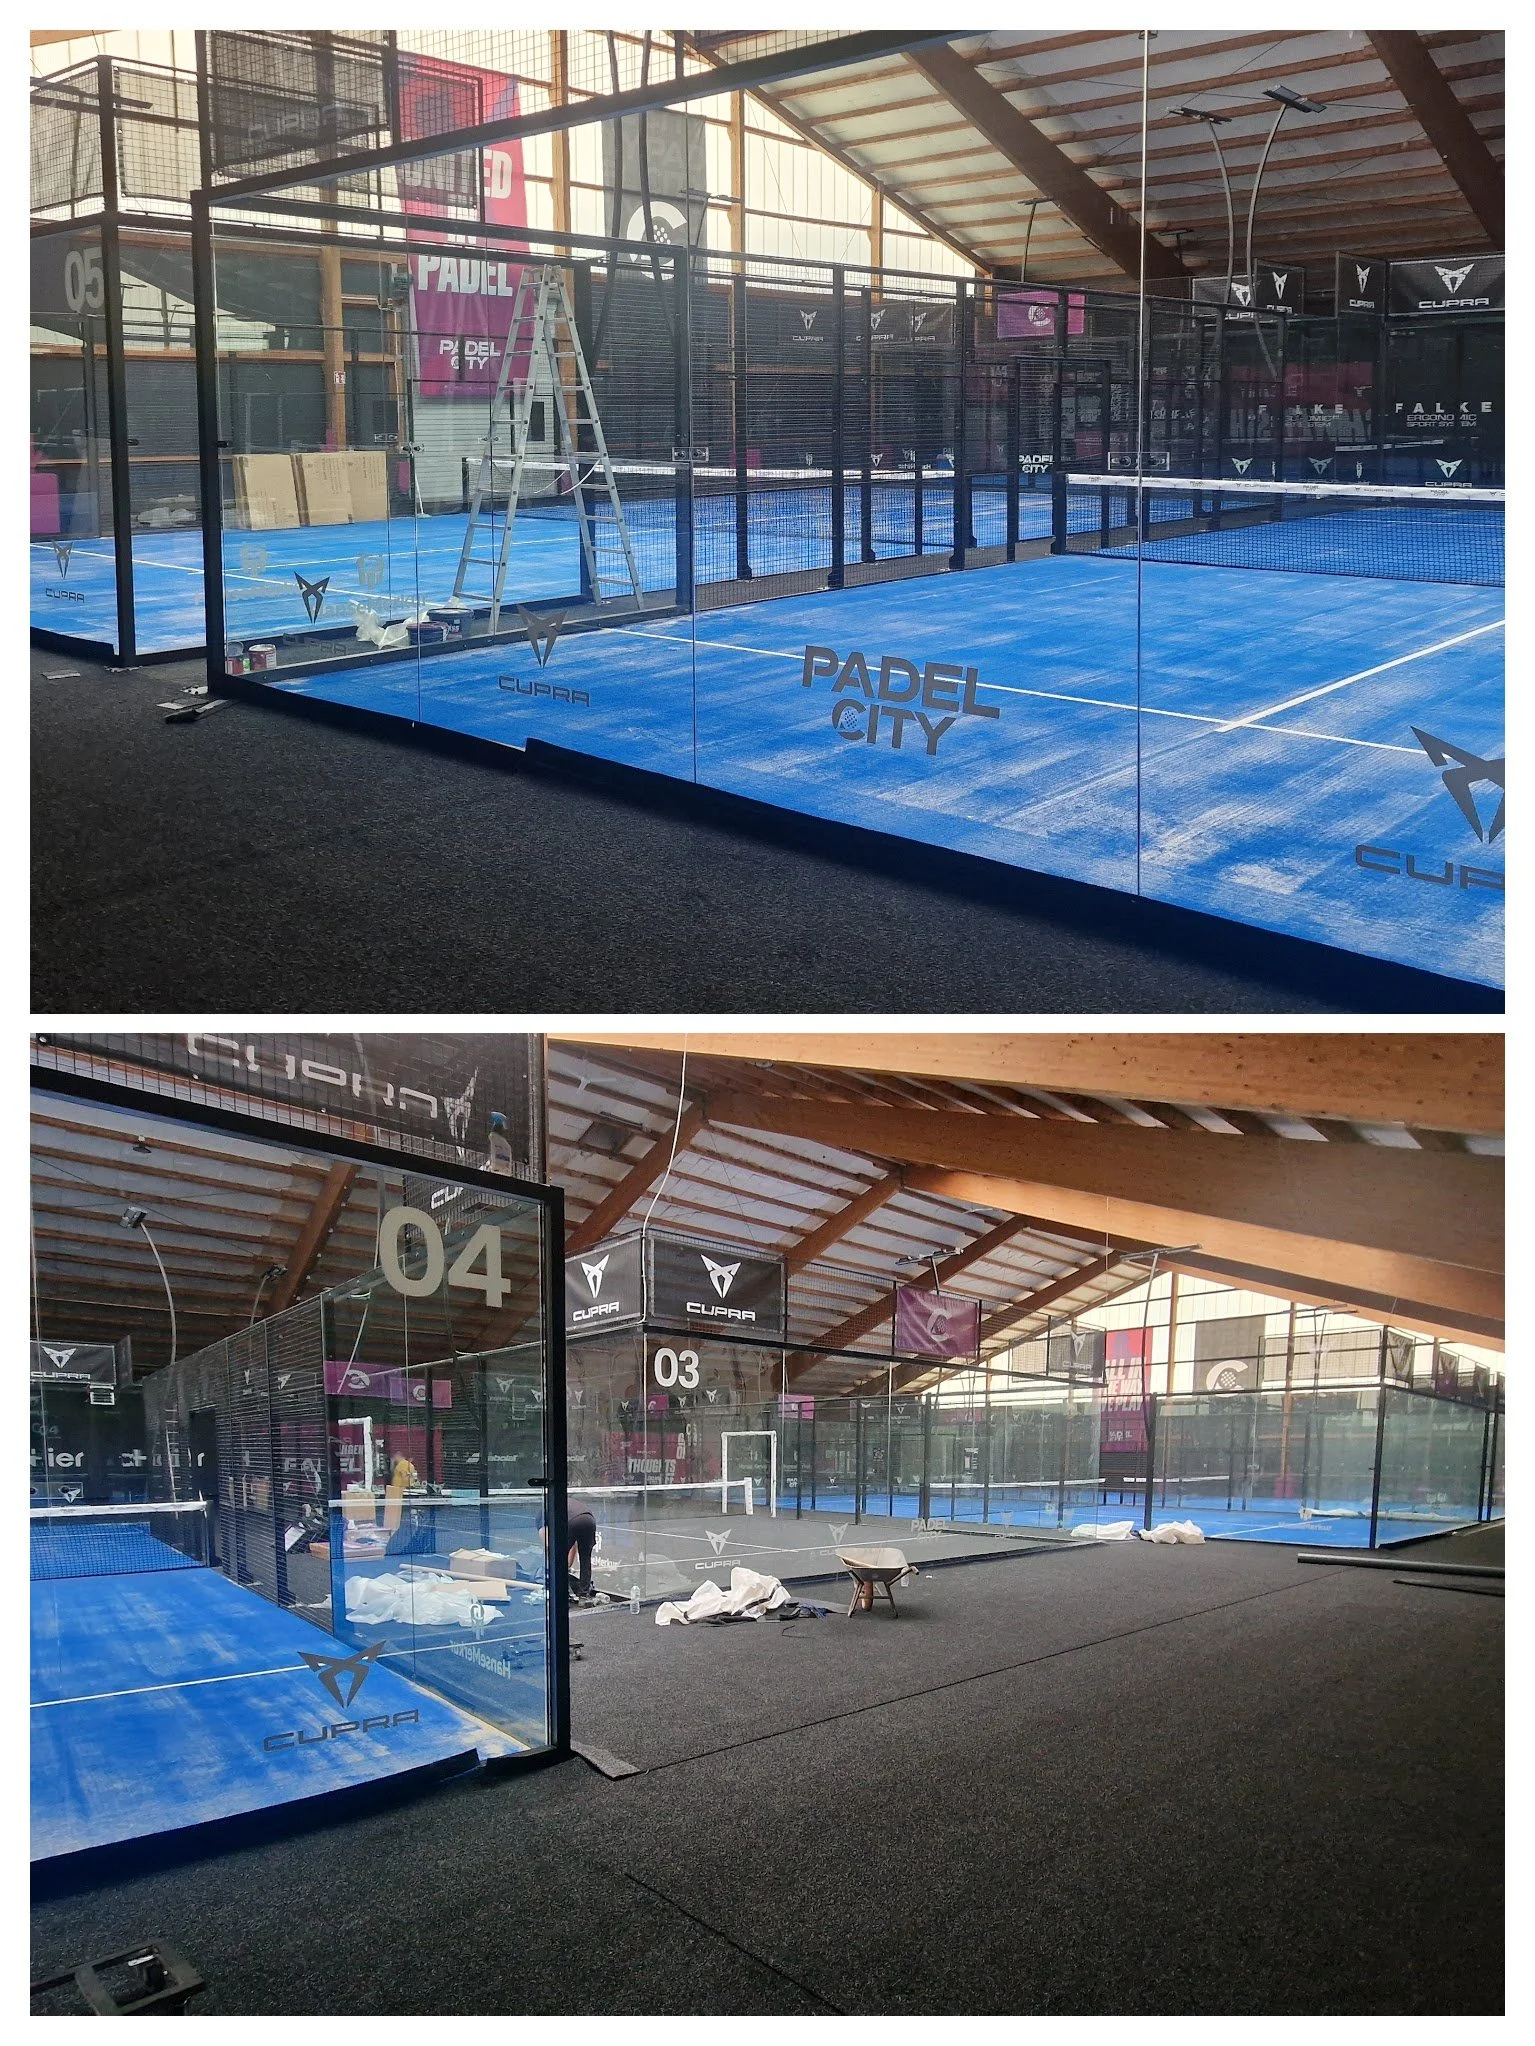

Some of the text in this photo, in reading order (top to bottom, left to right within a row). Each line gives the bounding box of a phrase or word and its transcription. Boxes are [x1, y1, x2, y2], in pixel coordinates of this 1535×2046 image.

[64, 246, 105, 314] 05
[417, 254, 514, 297] PADEL
[1349, 299, 1375, 309] CUPRA
[1418, 297, 1490, 310] CUPRA
[855, 333, 894, 342] CPRA
[450, 355, 490, 370] CTY
[45, 587, 85, 604] CUPRA
[498, 676, 591, 708] CUPRA
[803, 645, 1001, 720] PADEL
[832, 698, 957, 757] CITY
[379, 1206, 512, 1309] 04
[572, 1301, 620, 1323] CUPRA
[686, 1301, 756, 1322] CUPRA
[29, 1371, 91, 1380] CUPRA
[653, 1347, 701, 1389] 03
[1062, 1360, 1093, 1371] CUPRA
[911, 1518, 947, 1532] PADEL
[694, 1558, 741, 1570] CUPRA
[262, 1708, 420, 1752] CUPRA
